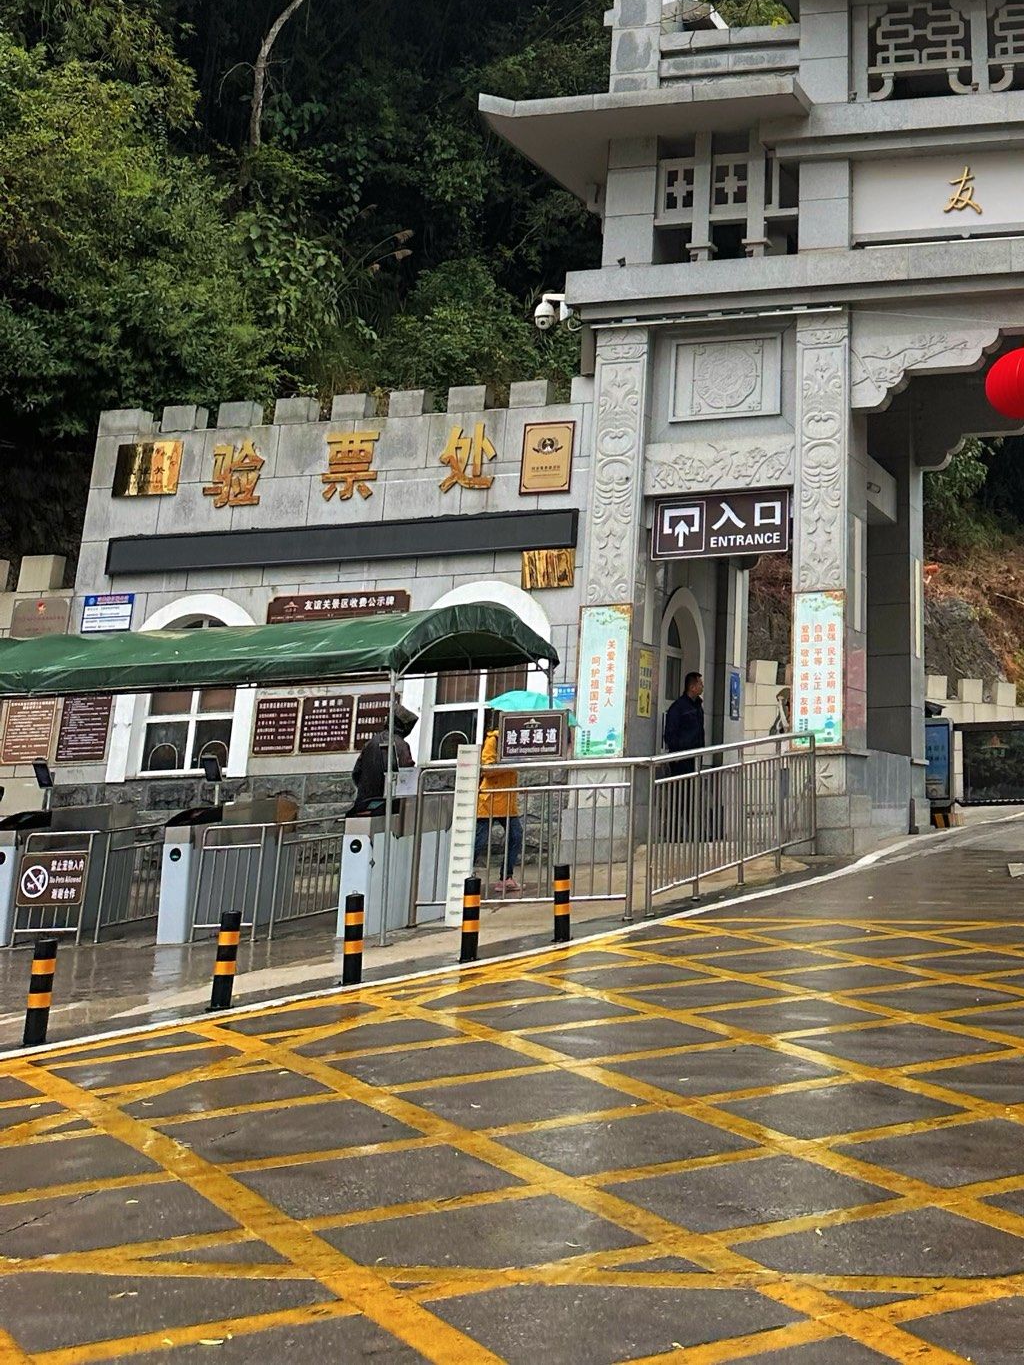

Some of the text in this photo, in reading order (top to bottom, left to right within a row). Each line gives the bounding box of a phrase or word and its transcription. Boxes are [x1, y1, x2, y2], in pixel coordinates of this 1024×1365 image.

[203, 422, 497, 508] 验票处
[711, 501, 782, 531] 入口
[710, 532, 780, 548] ENTRANCE
[304, 595, 395, 611] 友谊关景区收费公示牌
[801, 625, 809, 643] 爱国
[801, 649, 809, 667] 敬业
[604, 640, 617, 707] 关爱未成年人
[813, 624, 822, 715] 自由 平等 公正 法治
[827, 623, 836, 714] 富强 民主 文明 和谐
[588, 655, 601, 725] 呵护祖国花朵
[800, 672, 809, 691] 诚信
[800, 697, 809, 715] 友善
[506, 728, 557, 745] 验票通道
[50, 859, 85, 872] 禁止宠物入内
